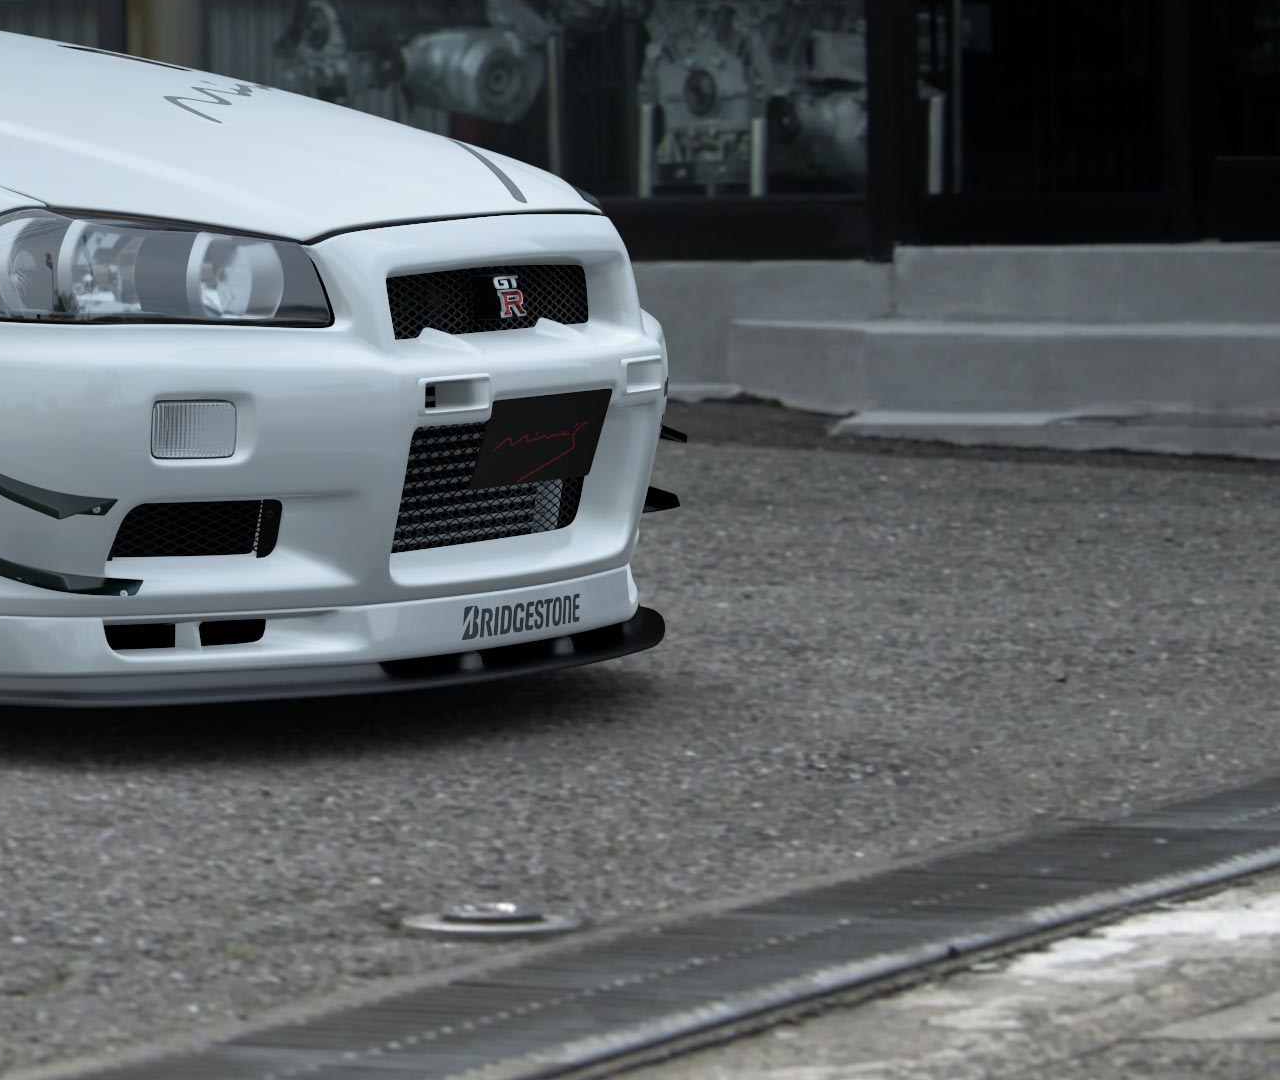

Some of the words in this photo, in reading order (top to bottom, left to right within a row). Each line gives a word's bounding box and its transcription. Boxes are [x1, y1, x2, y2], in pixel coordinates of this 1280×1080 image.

[492, 274, 519, 289] GT
[496, 288, 527, 319] R
[461, 593, 580, 641] BRIDGESTONE
